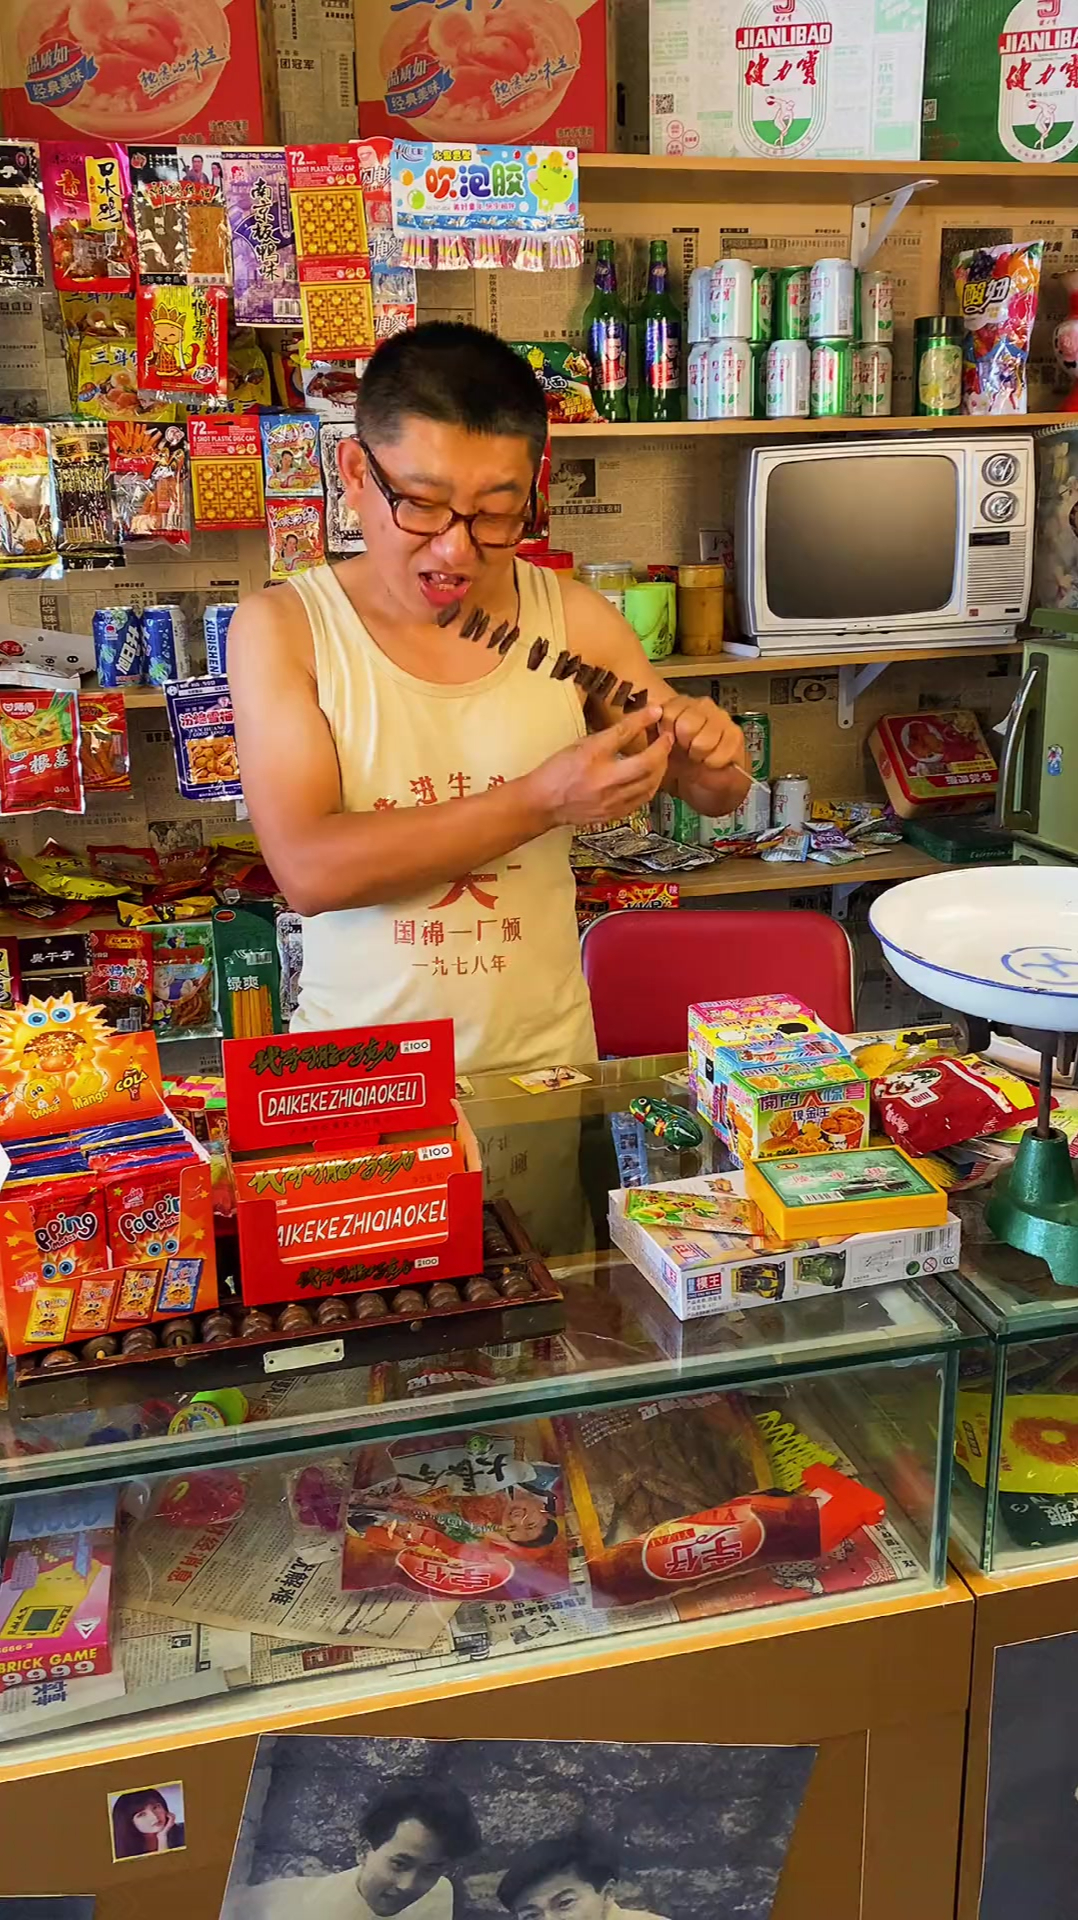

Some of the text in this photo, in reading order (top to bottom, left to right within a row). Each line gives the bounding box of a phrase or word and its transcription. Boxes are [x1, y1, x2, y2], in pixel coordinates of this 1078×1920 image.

[737, 25, 830, 48] JIANLIBAO
[27, 45, 82, 76] 品质如一
[280, 58, 315, 69] 团冠军
[388, 55, 440, 87] 品质如一
[32, 66, 85, 100] 经典美味
[391, 84, 441, 112] 经典美味
[289, 152, 305, 165] 72
[311, 165, 330, 173] PLASTIC
[361, 164, 391, 185] 闪电
[425, 162, 524, 199] 吹泡胶
[97, 162, 122, 223] 口水鸡
[251, 177, 281, 283] 南京板鸭味
[191, 421, 207, 435] 72
[393, 917, 522, 947] 国棉一厂颁
[30, 950, 74, 964] 臭干子
[411, 954, 508, 977] 一九七八年
[227, 975, 260, 992] 绿爽
[115, 1070, 148, 1092] COLA
[72, 1090, 110, 1110] Mango
[266, 1080, 418, 1118] DAIKEKEZHIQIAOKELI
[31, 1104, 61, 1120] ORANGE
[429, 1146, 449, 1156] 100
[0, 1648, 98, 1673] BRICK GAME
[2, 1660, 95, 1685] 9999
